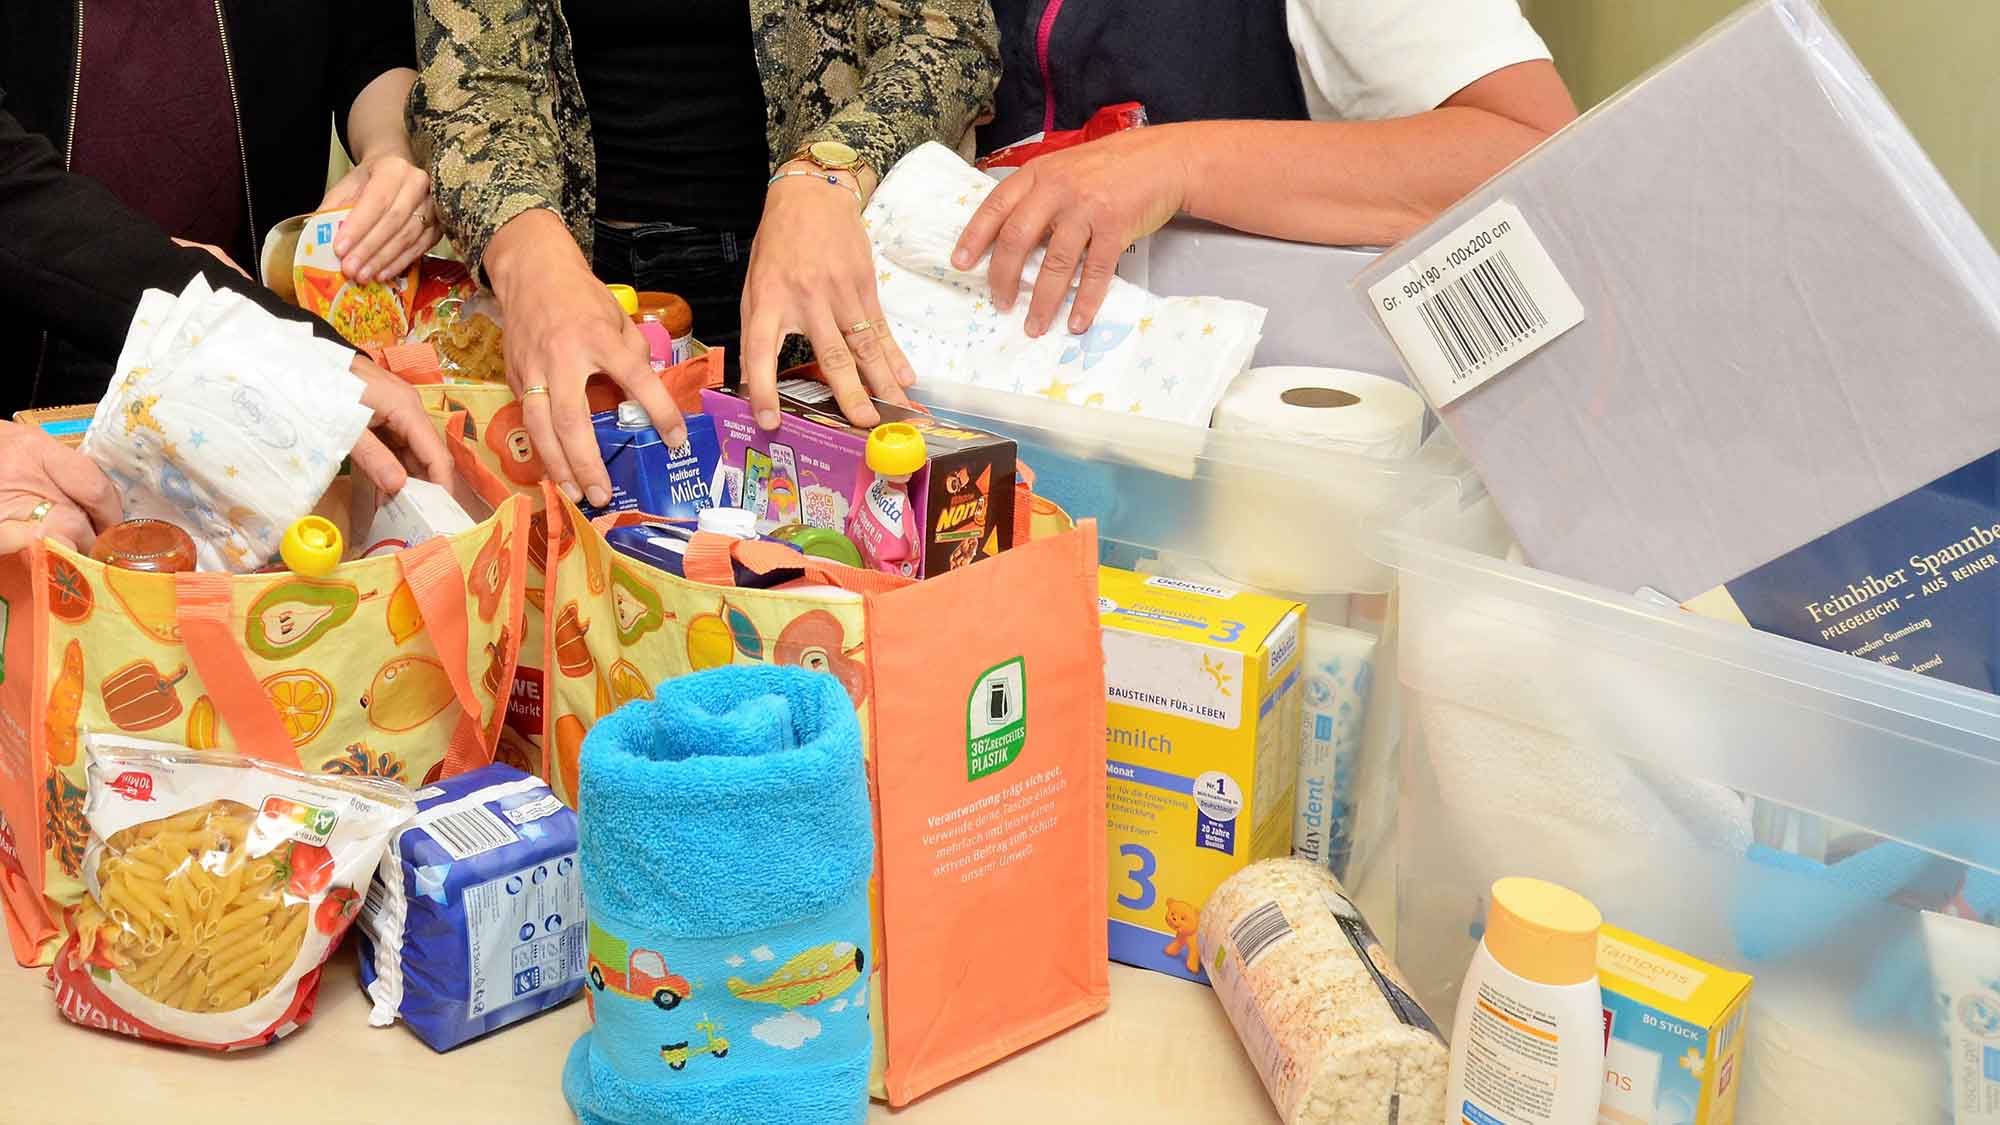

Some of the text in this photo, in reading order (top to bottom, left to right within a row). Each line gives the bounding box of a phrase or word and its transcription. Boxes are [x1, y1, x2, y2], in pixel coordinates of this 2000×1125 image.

[1383, 295, 1402, 312] Gr.
[1402, 266, 1441, 299] 90x190
[1446, 231, 1493, 270] 100x200
[1492, 219, 1512, 239] cm
[669, 467, 700, 483] Haltbare
[671, 477, 709, 505] Milch
[1805, 568, 1909, 624] Feinbiber
[1821, 598, 1900, 641] PFLEGELEICHT
[1921, 577, 1949, 596] AUS
[1951, 554, 1999, 582] REINER
[1208, 619, 1246, 643] 3
[1851, 618, 1932, 656] rundum Gummizug
[508, 699, 541, 718] Markt
[1108, 687, 1168, 707] BAUSTEINEN
[1196, 705, 1227, 720] LEBEN
[990, 726, 1025, 750] RECYCELTES
[1106, 727, 1172, 755] emilch
[971, 747, 1009, 775] PLASTIK
[1217, 778, 1226, 796] 1
[928, 794, 1000, 828] Verantwortung
[922, 820, 973, 846] Verwende
[1211, 825, 1231, 839] Jahre
[1116, 843, 1158, 911] 3
[1602, 945, 1689, 985] Tampons
[1660, 1019, 1699, 1041] STÜCK
